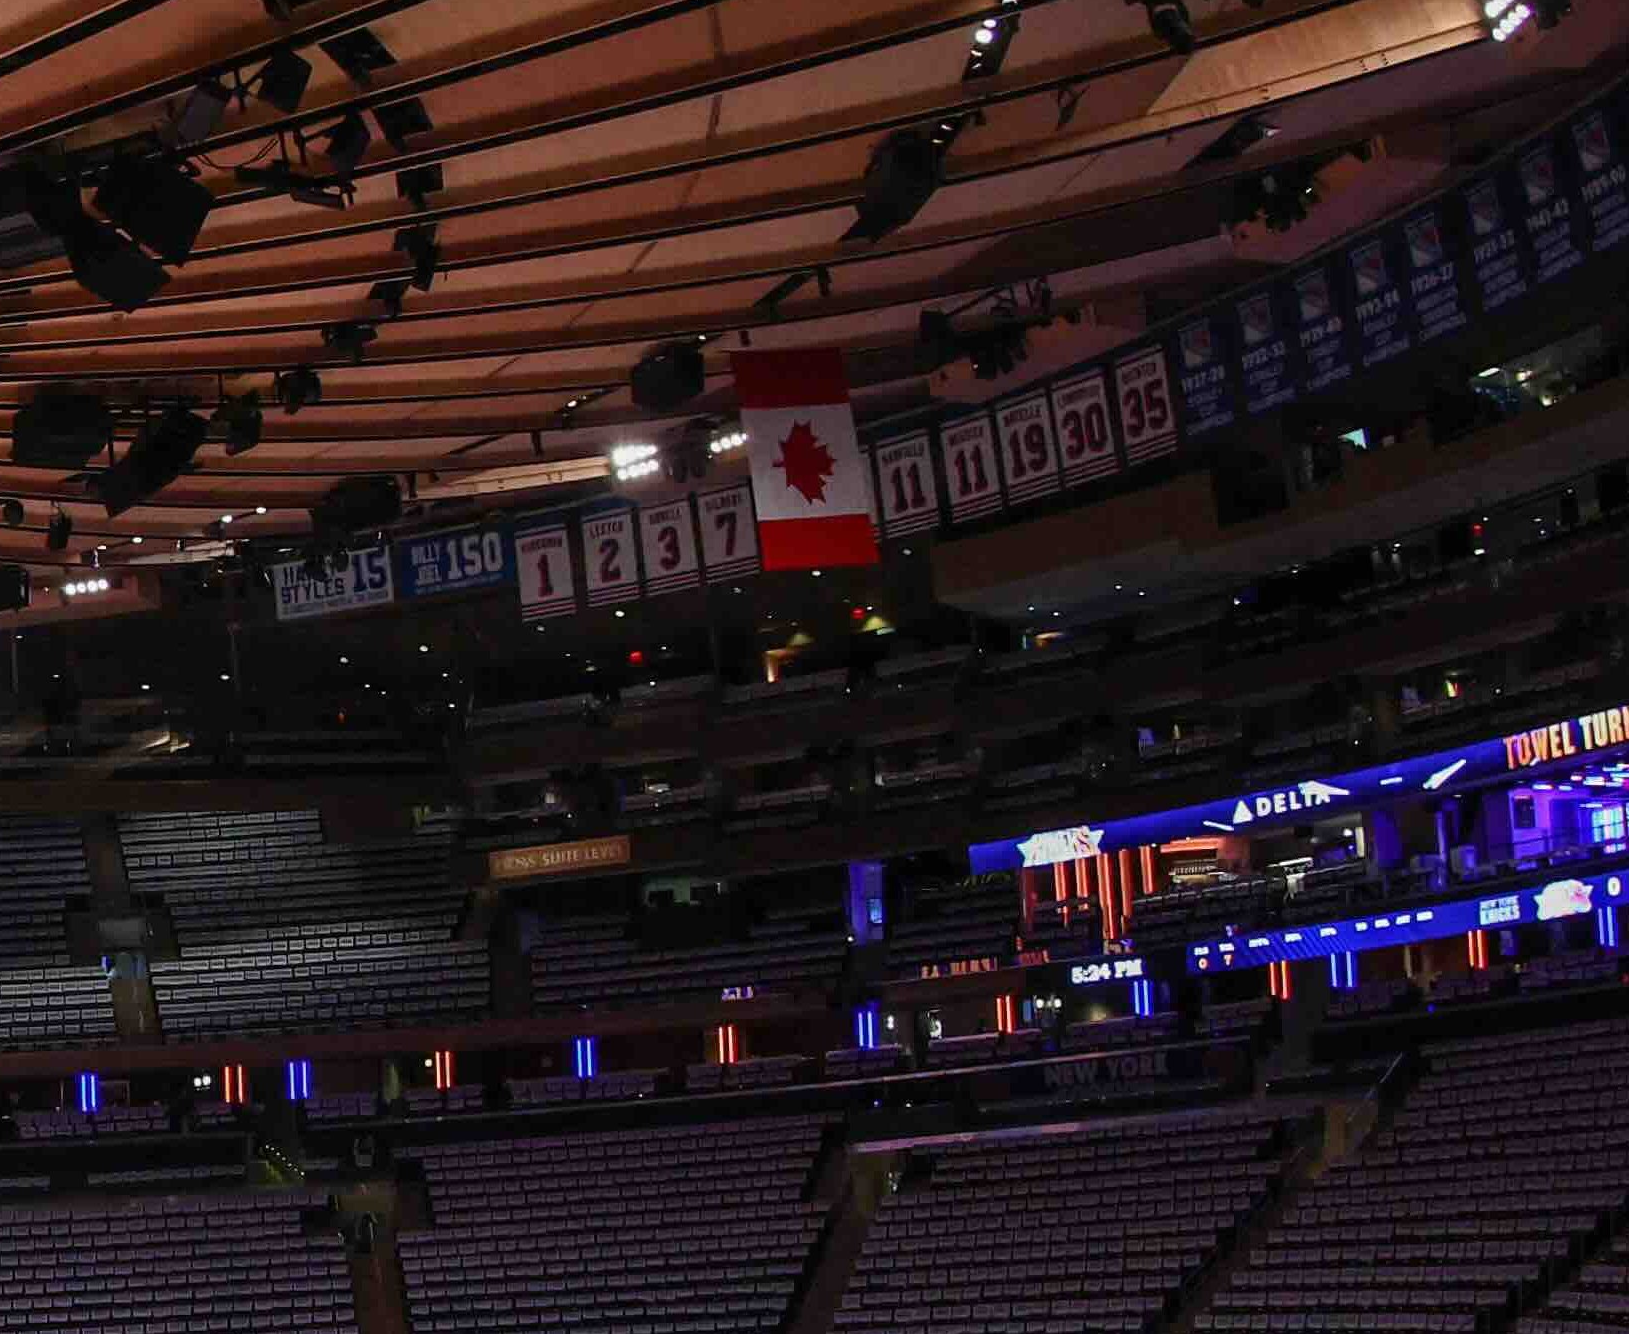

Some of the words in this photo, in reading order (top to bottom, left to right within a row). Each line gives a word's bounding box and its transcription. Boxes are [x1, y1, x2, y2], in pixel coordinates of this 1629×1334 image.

[1062, 402, 1107, 459] 30
[1122, 379, 1168, 438] 35
[954, 444, 988, 496] 11
[1008, 424, 1048, 479] 19
[890, 463, 926, 514] 11
[446, 532, 504, 580] 150
[657, 526, 682, 571] 3
[715, 511, 737, 556] 7
[352, 551, 388, 592] 15
[537, 554, 554, 597] 1
[598, 538, 621, 583] 2
[281, 578, 344, 604] STYLES
[1503, 721, 1576, 770] TOWEL
